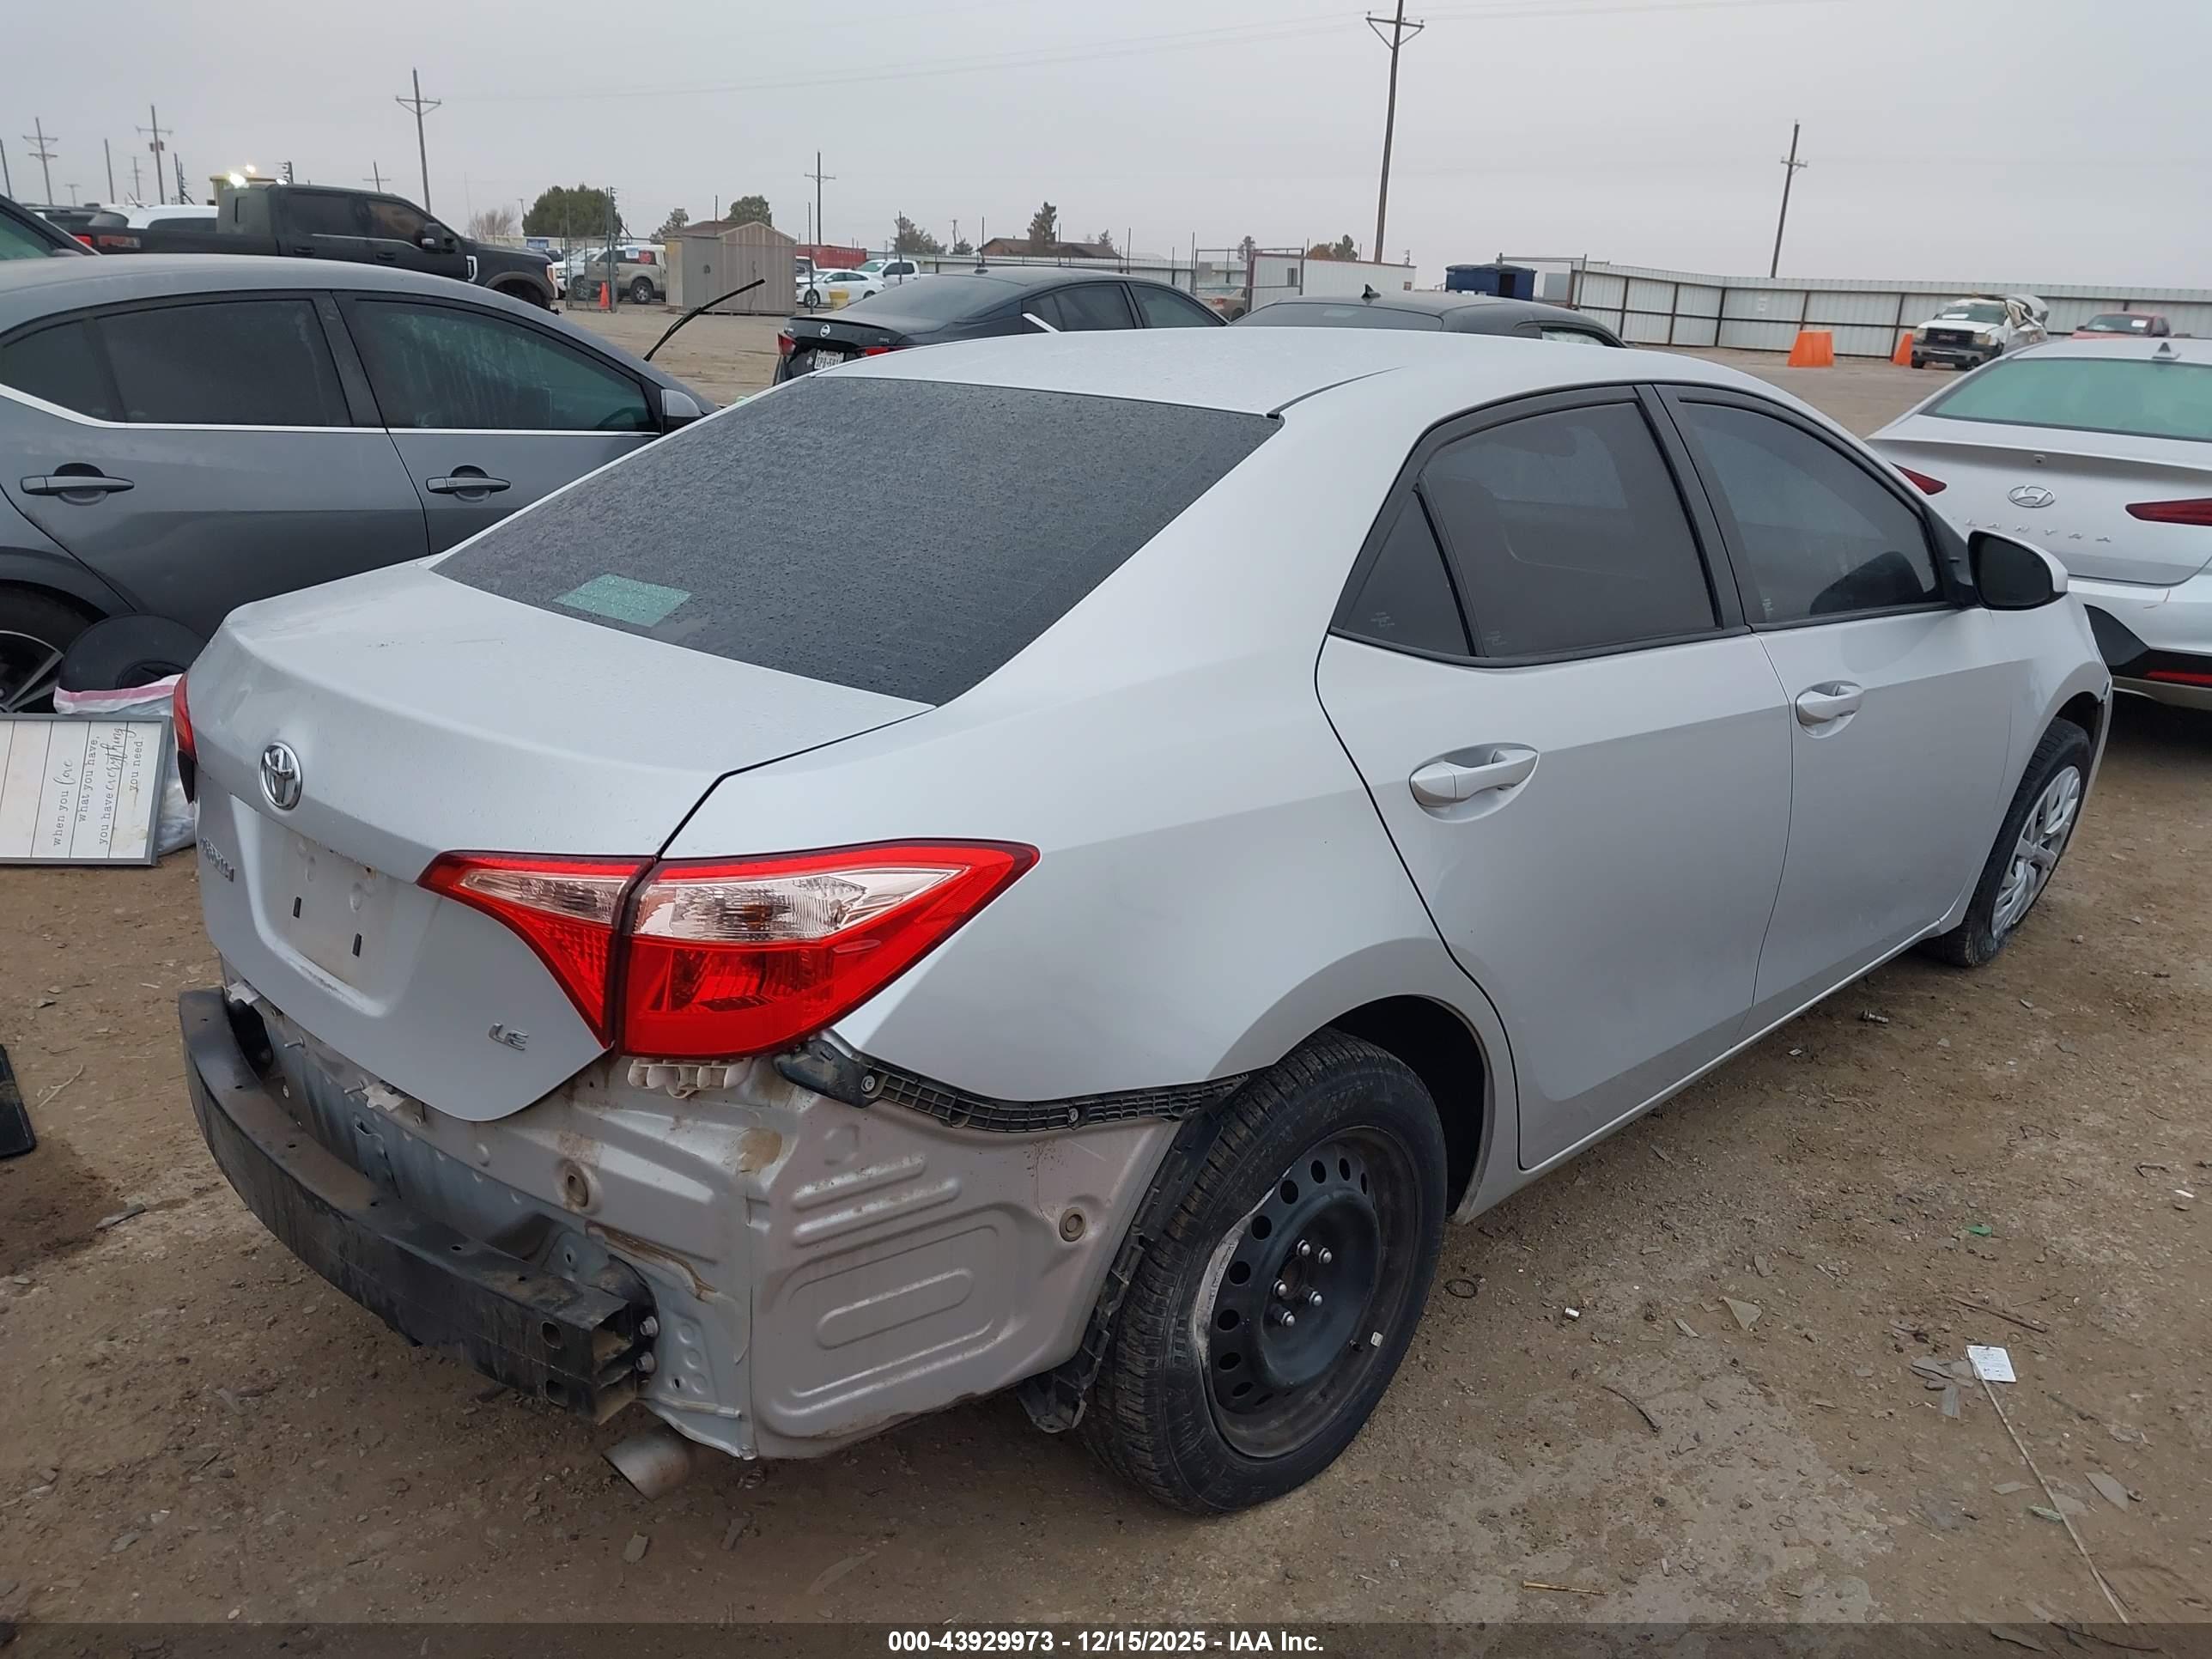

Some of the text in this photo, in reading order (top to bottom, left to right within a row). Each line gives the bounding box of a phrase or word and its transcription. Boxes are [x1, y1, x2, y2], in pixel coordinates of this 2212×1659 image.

[53, 759, 76, 847] when you love
[77, 736, 100, 822] what you have,
[99, 727, 137, 845] you have everything
[129, 771, 139, 792] you
[488, 1023, 529, 1051] LE
